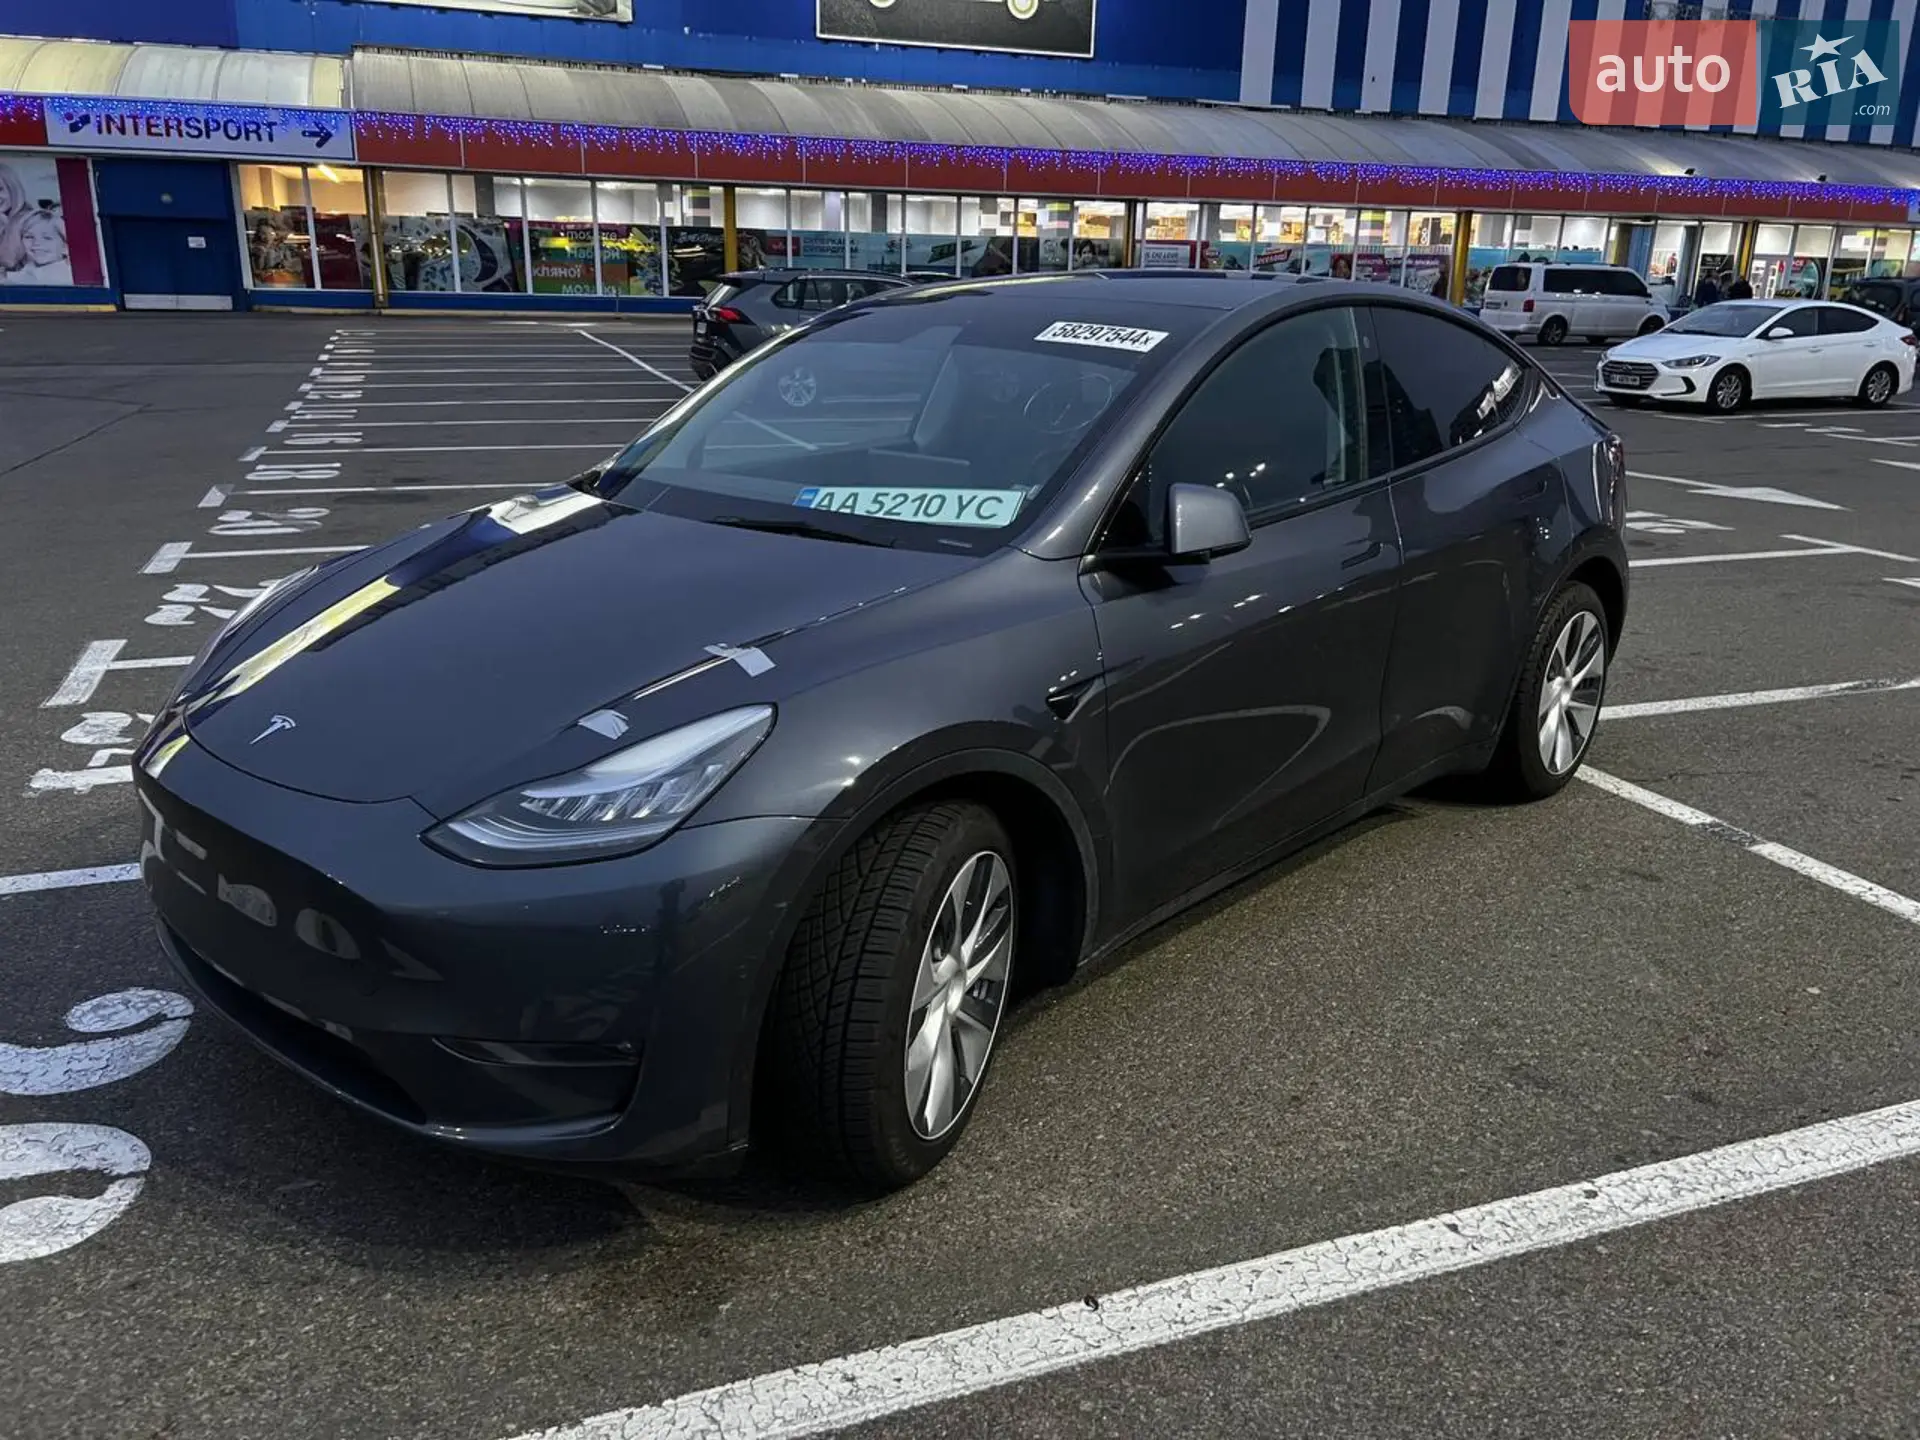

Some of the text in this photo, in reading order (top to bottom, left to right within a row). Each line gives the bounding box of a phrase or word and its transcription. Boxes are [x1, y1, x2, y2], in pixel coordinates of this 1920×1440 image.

[96, 113, 278, 143] INTERSPORT
[245, 463, 341, 480] 18
[814, 491, 1004, 520] AA 5210 YC
